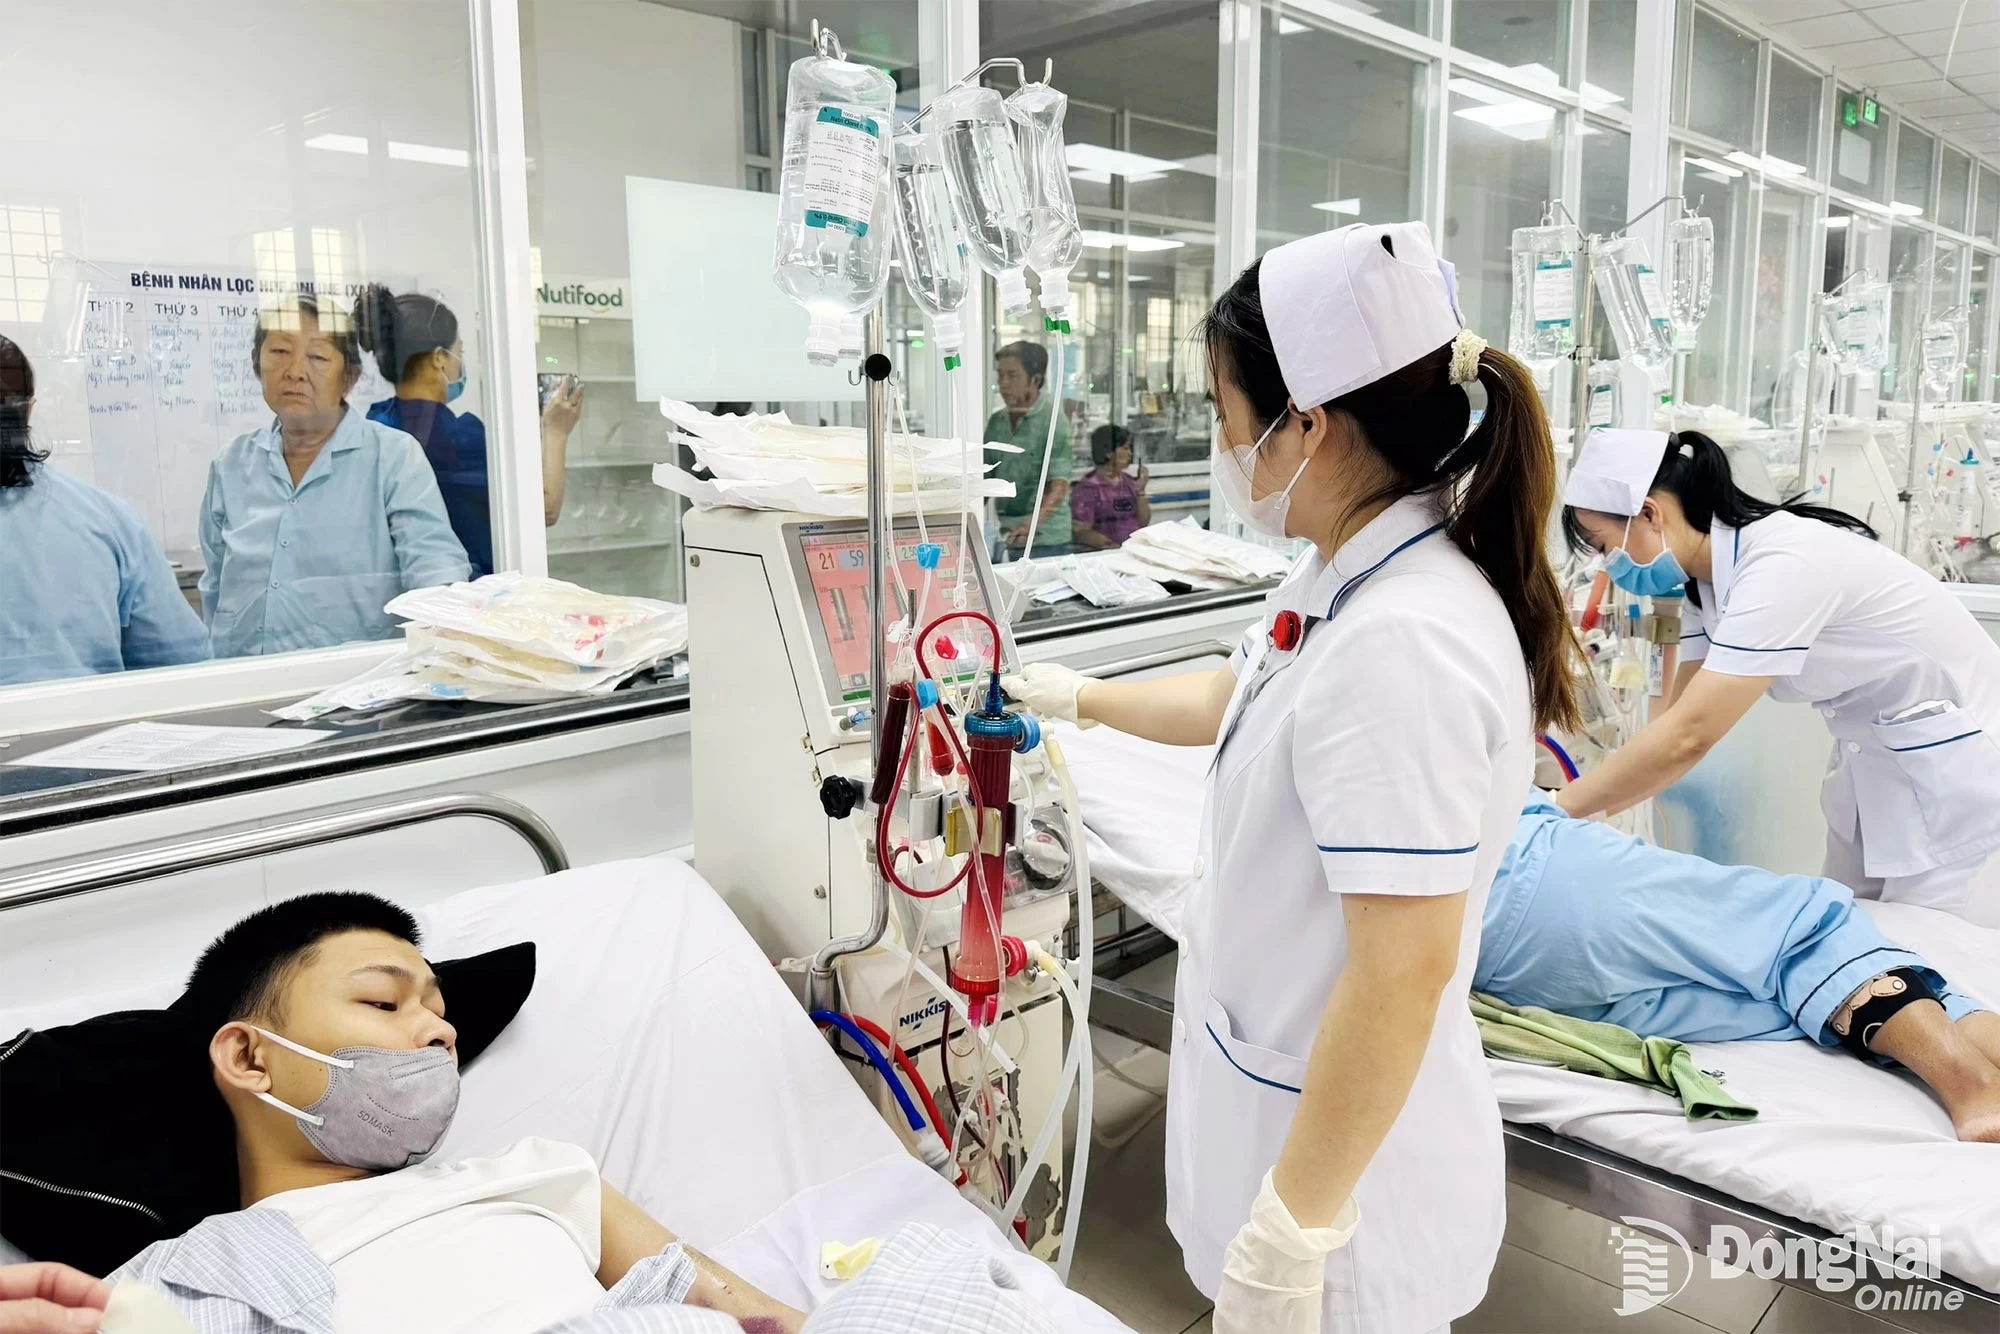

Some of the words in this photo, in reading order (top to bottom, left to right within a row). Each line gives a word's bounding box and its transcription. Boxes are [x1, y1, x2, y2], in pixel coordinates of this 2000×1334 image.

[131, 271, 174, 291] BỆNH
[178, 274, 222, 291] NHÂN
[227, 278, 254, 295] LỌC
[537, 282, 622, 307] Nutifood
[126, 301, 133, 313] 2
[154, 302, 186, 317] THỨ
[190, 304, 198, 316] 3
[218, 305, 247, 317] THỨ
[252, 308, 258, 316] 4
[819, 552, 835, 570] 21
[849, 549, 865, 567] 59
[899, 1000, 954, 1027] NIKKIS
